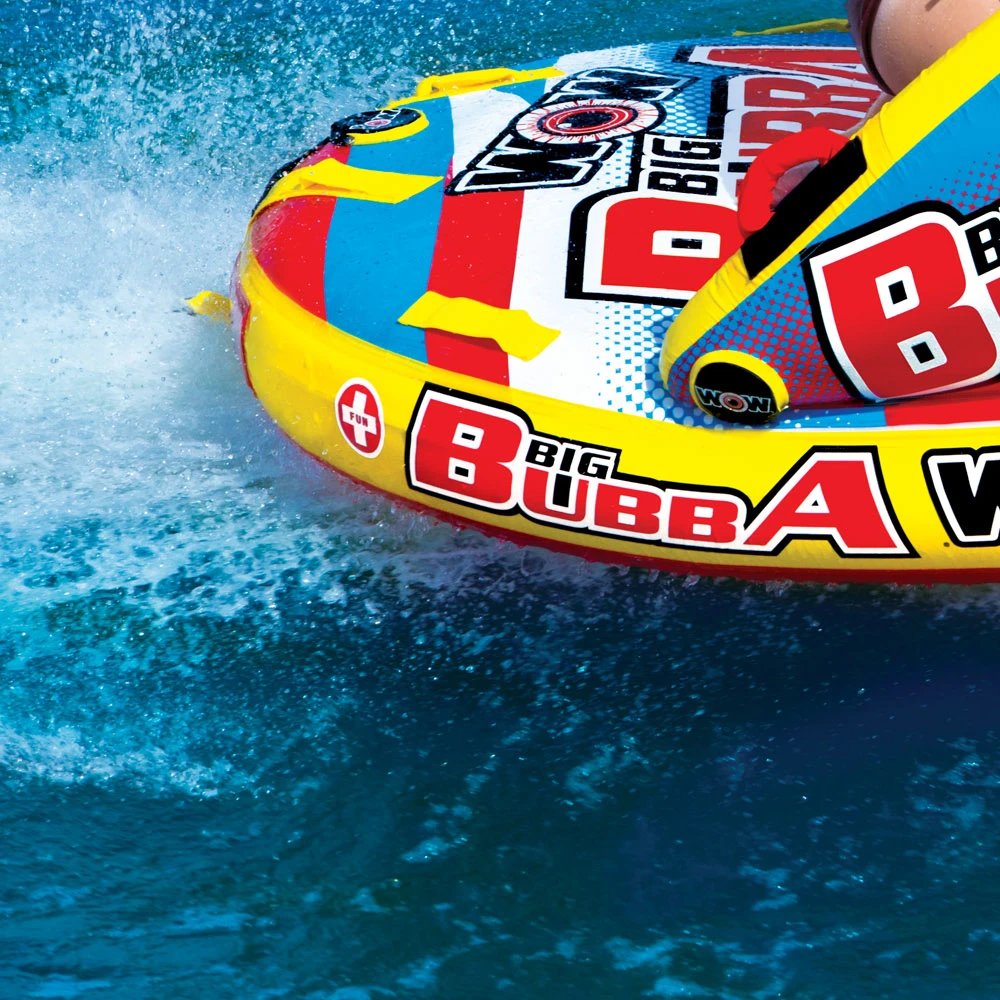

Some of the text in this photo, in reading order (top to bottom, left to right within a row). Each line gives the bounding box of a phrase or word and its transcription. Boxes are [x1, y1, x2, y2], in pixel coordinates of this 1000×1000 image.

[454, 68, 690, 191] WOW
[644, 135, 722, 197] BIG
[349, 411, 368, 427] FUN
[695, 385, 772, 414] WOW
[409, 390, 909, 554] BIG BUBBA
